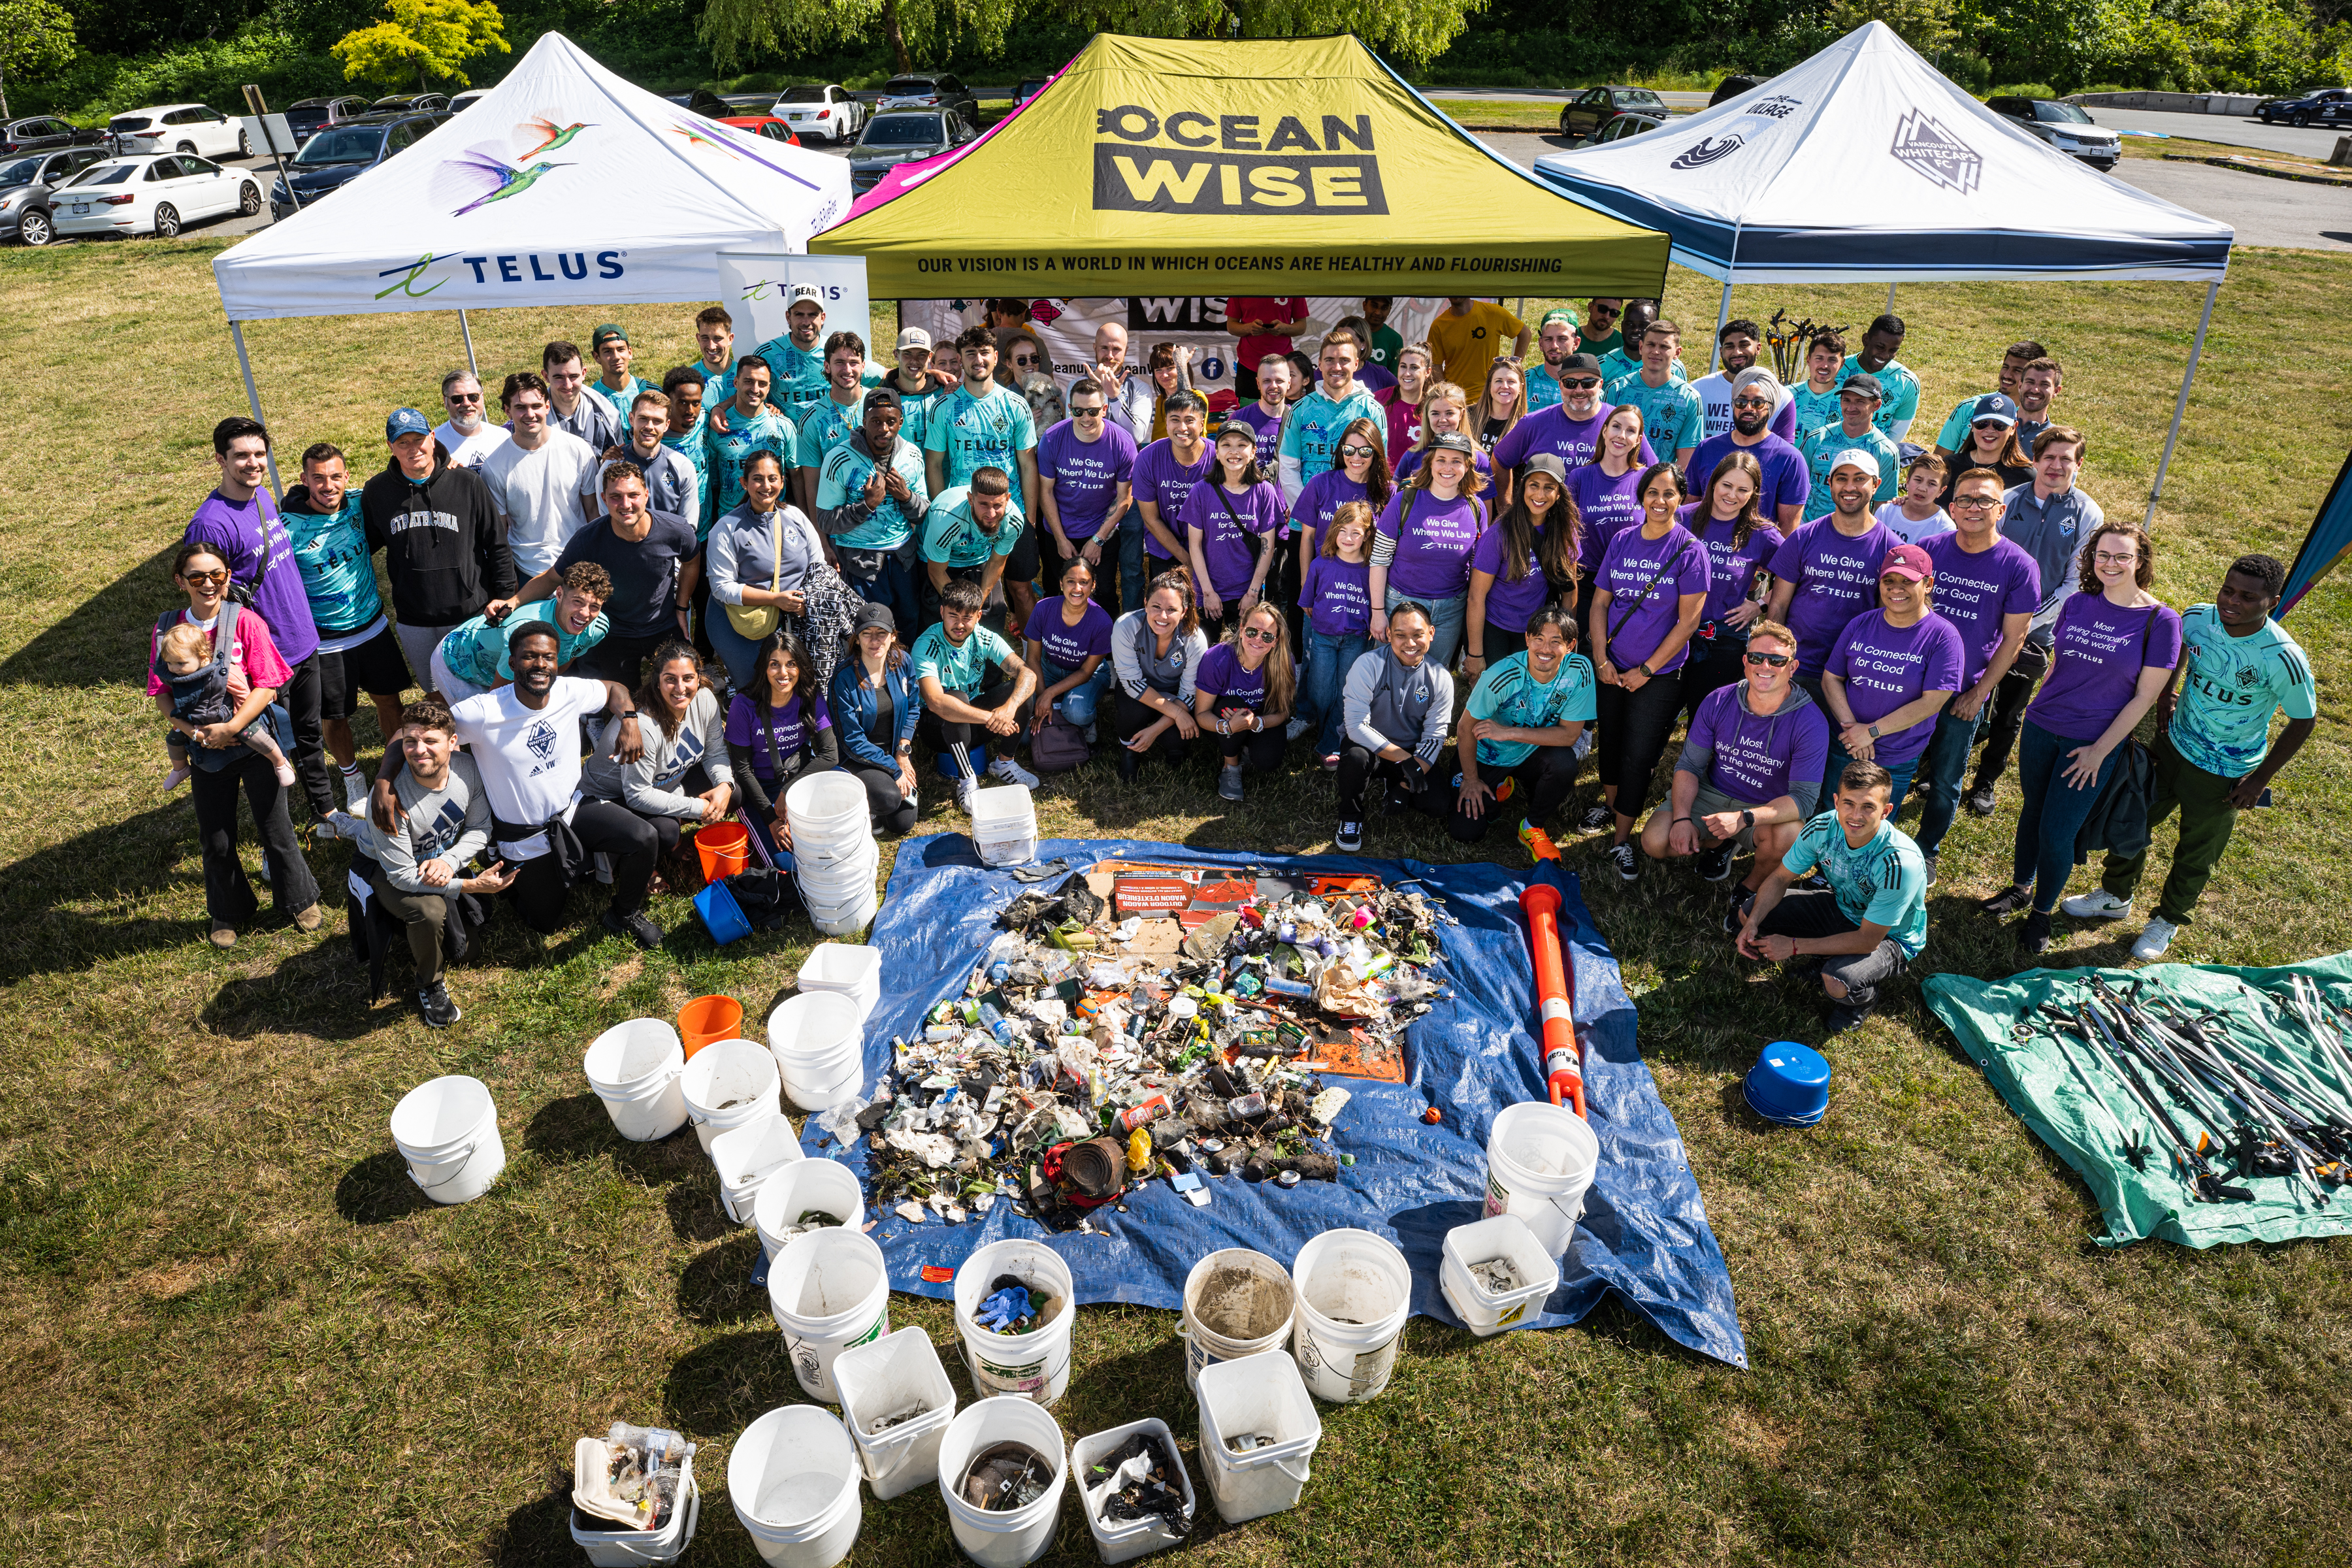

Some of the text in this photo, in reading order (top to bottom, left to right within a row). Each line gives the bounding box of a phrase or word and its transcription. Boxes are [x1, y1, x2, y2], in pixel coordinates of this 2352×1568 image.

[1774, 95, 1789, 104] THE
[1745, 103, 1795, 120] VILLAGE
[1094, 103, 1374, 154] OCEAN
[1907, 140, 1959, 151] VANCOUVER
[1893, 148, 1978, 163] WHITECAPS
[1935, 158, 1953, 169] FC
[1113, 161, 1374, 206] WISE
[918, 256, 1562, 272] OUR VISION IS A WORLD IN WHICH OCEANS ARE HEALTHY AND FLOURISHING
[795, 287, 817, 297] BEAR
[1139, 297, 1229, 323] WIS
[1707, 402, 1729, 417] WE
[955, 439, 1008, 451] TELUS
[1255, 434, 1267, 443] We
[1557, 440, 1575, 451] We
[1070, 458, 1104, 468] We Give
[1056, 466, 1115, 480] Where We Live
[1172, 480, 1196, 489] Conne
[1587, 504, 1612, 514] Where
[391, 511, 459, 535] STRATHCONA
[1426, 518, 1459, 528] We Give
[272, 532, 283, 544] We
[1412, 527, 1471, 539] Where We Live
[1437, 542, 1464, 551] TELUS
[1710, 540, 1733, 553] Give
[277, 547, 290, 561] TELU
[313, 540, 364, 574] TELU
[1708, 553, 1746, 568] We Live
[1820, 553, 1865, 569] We Give
[1624, 558, 1661, 570] We Give
[1637, 572, 1652, 582] We
[1712, 571, 1732, 581] LUS
[1805, 565, 1876, 586] Where We Live
[1335, 581, 1363, 593] We Give
[1938, 572, 1999, 594] Connected
[1325, 591, 1370, 606] Where We Live
[1828, 587, 1861, 600] TELUS
[1933, 584, 1980, 603] for Good
[1343, 606, 1360, 615] TELUS
[1944, 606, 1978, 620] TELUS
[2093, 620, 2115, 632] Most
[1051, 633, 1078, 647] We Give
[2066, 623, 2131, 647] giving company
[2065, 632, 2117, 653] in the world.
[1061, 646, 1072, 655] We
[1850, 640, 1923, 664] All Connected
[2078, 652, 2104, 664] TELUS
[1854, 656, 1905, 676] for Good
[1867, 678, 1904, 693] TELUS
[2193, 673, 2253, 706] ELUS
[528, 733, 556, 747] WHITECAPS
[533, 732, 551, 740] VANCOUVER
[777, 732, 799, 743] Good
[1740, 735, 1763, 749] Most
[1716, 740, 1785, 769] giving company
[1719, 753, 1773, 777] in the world.
[1736, 771, 1763, 789] TELUS
[1117, 893, 1160, 902] D'EXTÉRIEUR
[1501, 1307, 1523, 1324] APR
